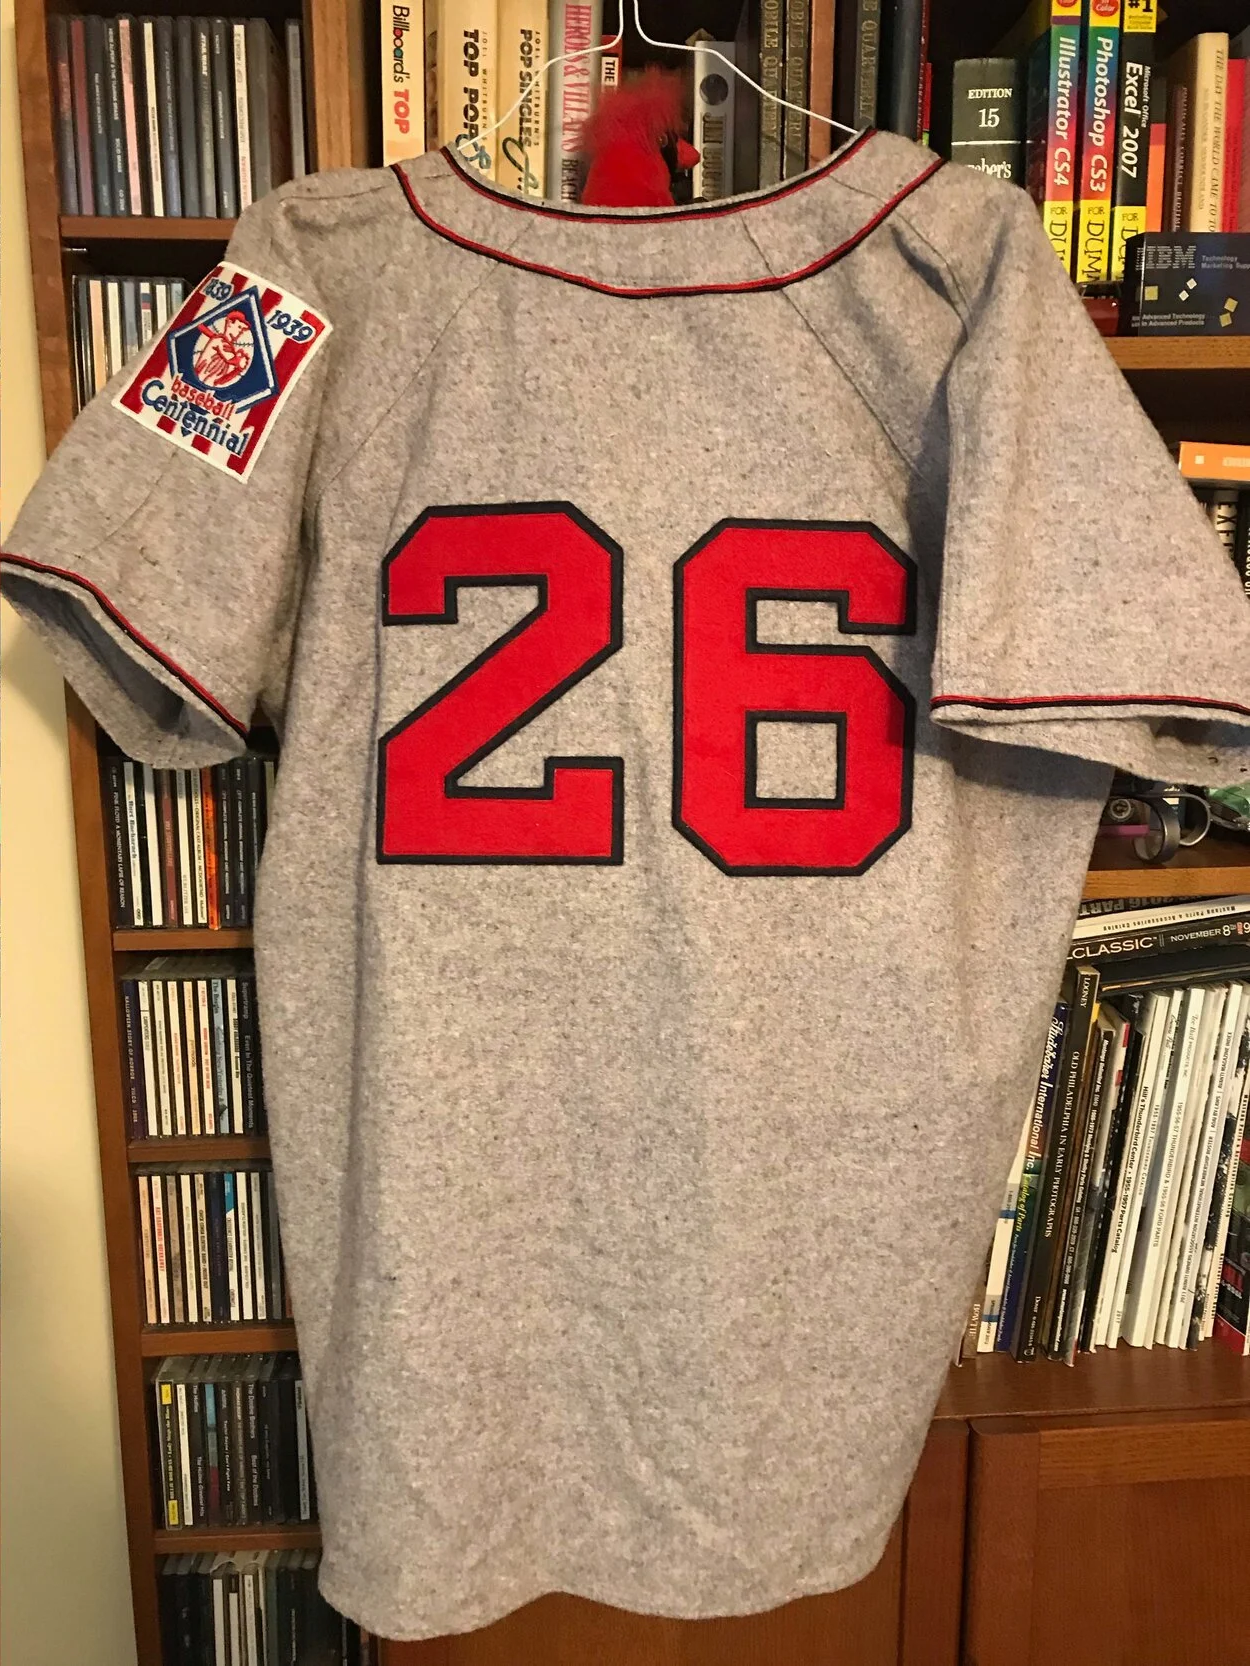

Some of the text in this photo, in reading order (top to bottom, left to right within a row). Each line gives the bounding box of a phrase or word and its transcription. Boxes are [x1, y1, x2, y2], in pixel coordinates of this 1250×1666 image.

[564, 4, 592, 63] HEROES
[391, 4, 410, 134] Billboard's TOP
[463, 29, 479, 137] TOP POP
[519, 29, 533, 147] POP SINGLES
[564, 65, 591, 77] &
[605, 59, 616, 82] THE
[859, 20, 877, 119] QUARTERLY
[968, 88, 1012, 99] EDITION
[1053, 36, 1076, 186] Illustrator CS4
[1087, 36, 1113, 193] Photoshop CS3
[1139, 65, 1151, 128] Microsoft Office
[978, 108, 1000, 128] 15
[1120, 61, 1143, 178] Excel 2007
[561, 159, 578, 200] BEACH
[1050, 207, 1067, 215] FOR
[1088, 207, 1105, 215] FOR
[1122, 213, 1138, 222] FOR
[1146, 246, 1197, 269] IBM
[203, 278, 232, 300] 1839
[266, 309, 314, 341] 1939
[142, 380, 250, 456] Centennial
[171, 375, 235, 420] baseball
[377, 501, 918, 876] 26
[1015, 1016, 1064, 1232] Studebaker International Inc. Catalog of Parts
[1044, 977, 1090, 1238] LOONEY OLD PHILADELPHIA IN EARLY PHOTOGRAPHS
[1172, 1102, 1184, 1132] 1955-56-57
[1111, 1086, 1149, 1254] Hill's Thunderbird Center 1955-1957 Parts Catalog
[1164, 1134, 1179, 1178] THUNDERBIRD
[1152, 1227, 1162, 1247] PARTS
[1156, 1208, 1165, 1227] FORD
